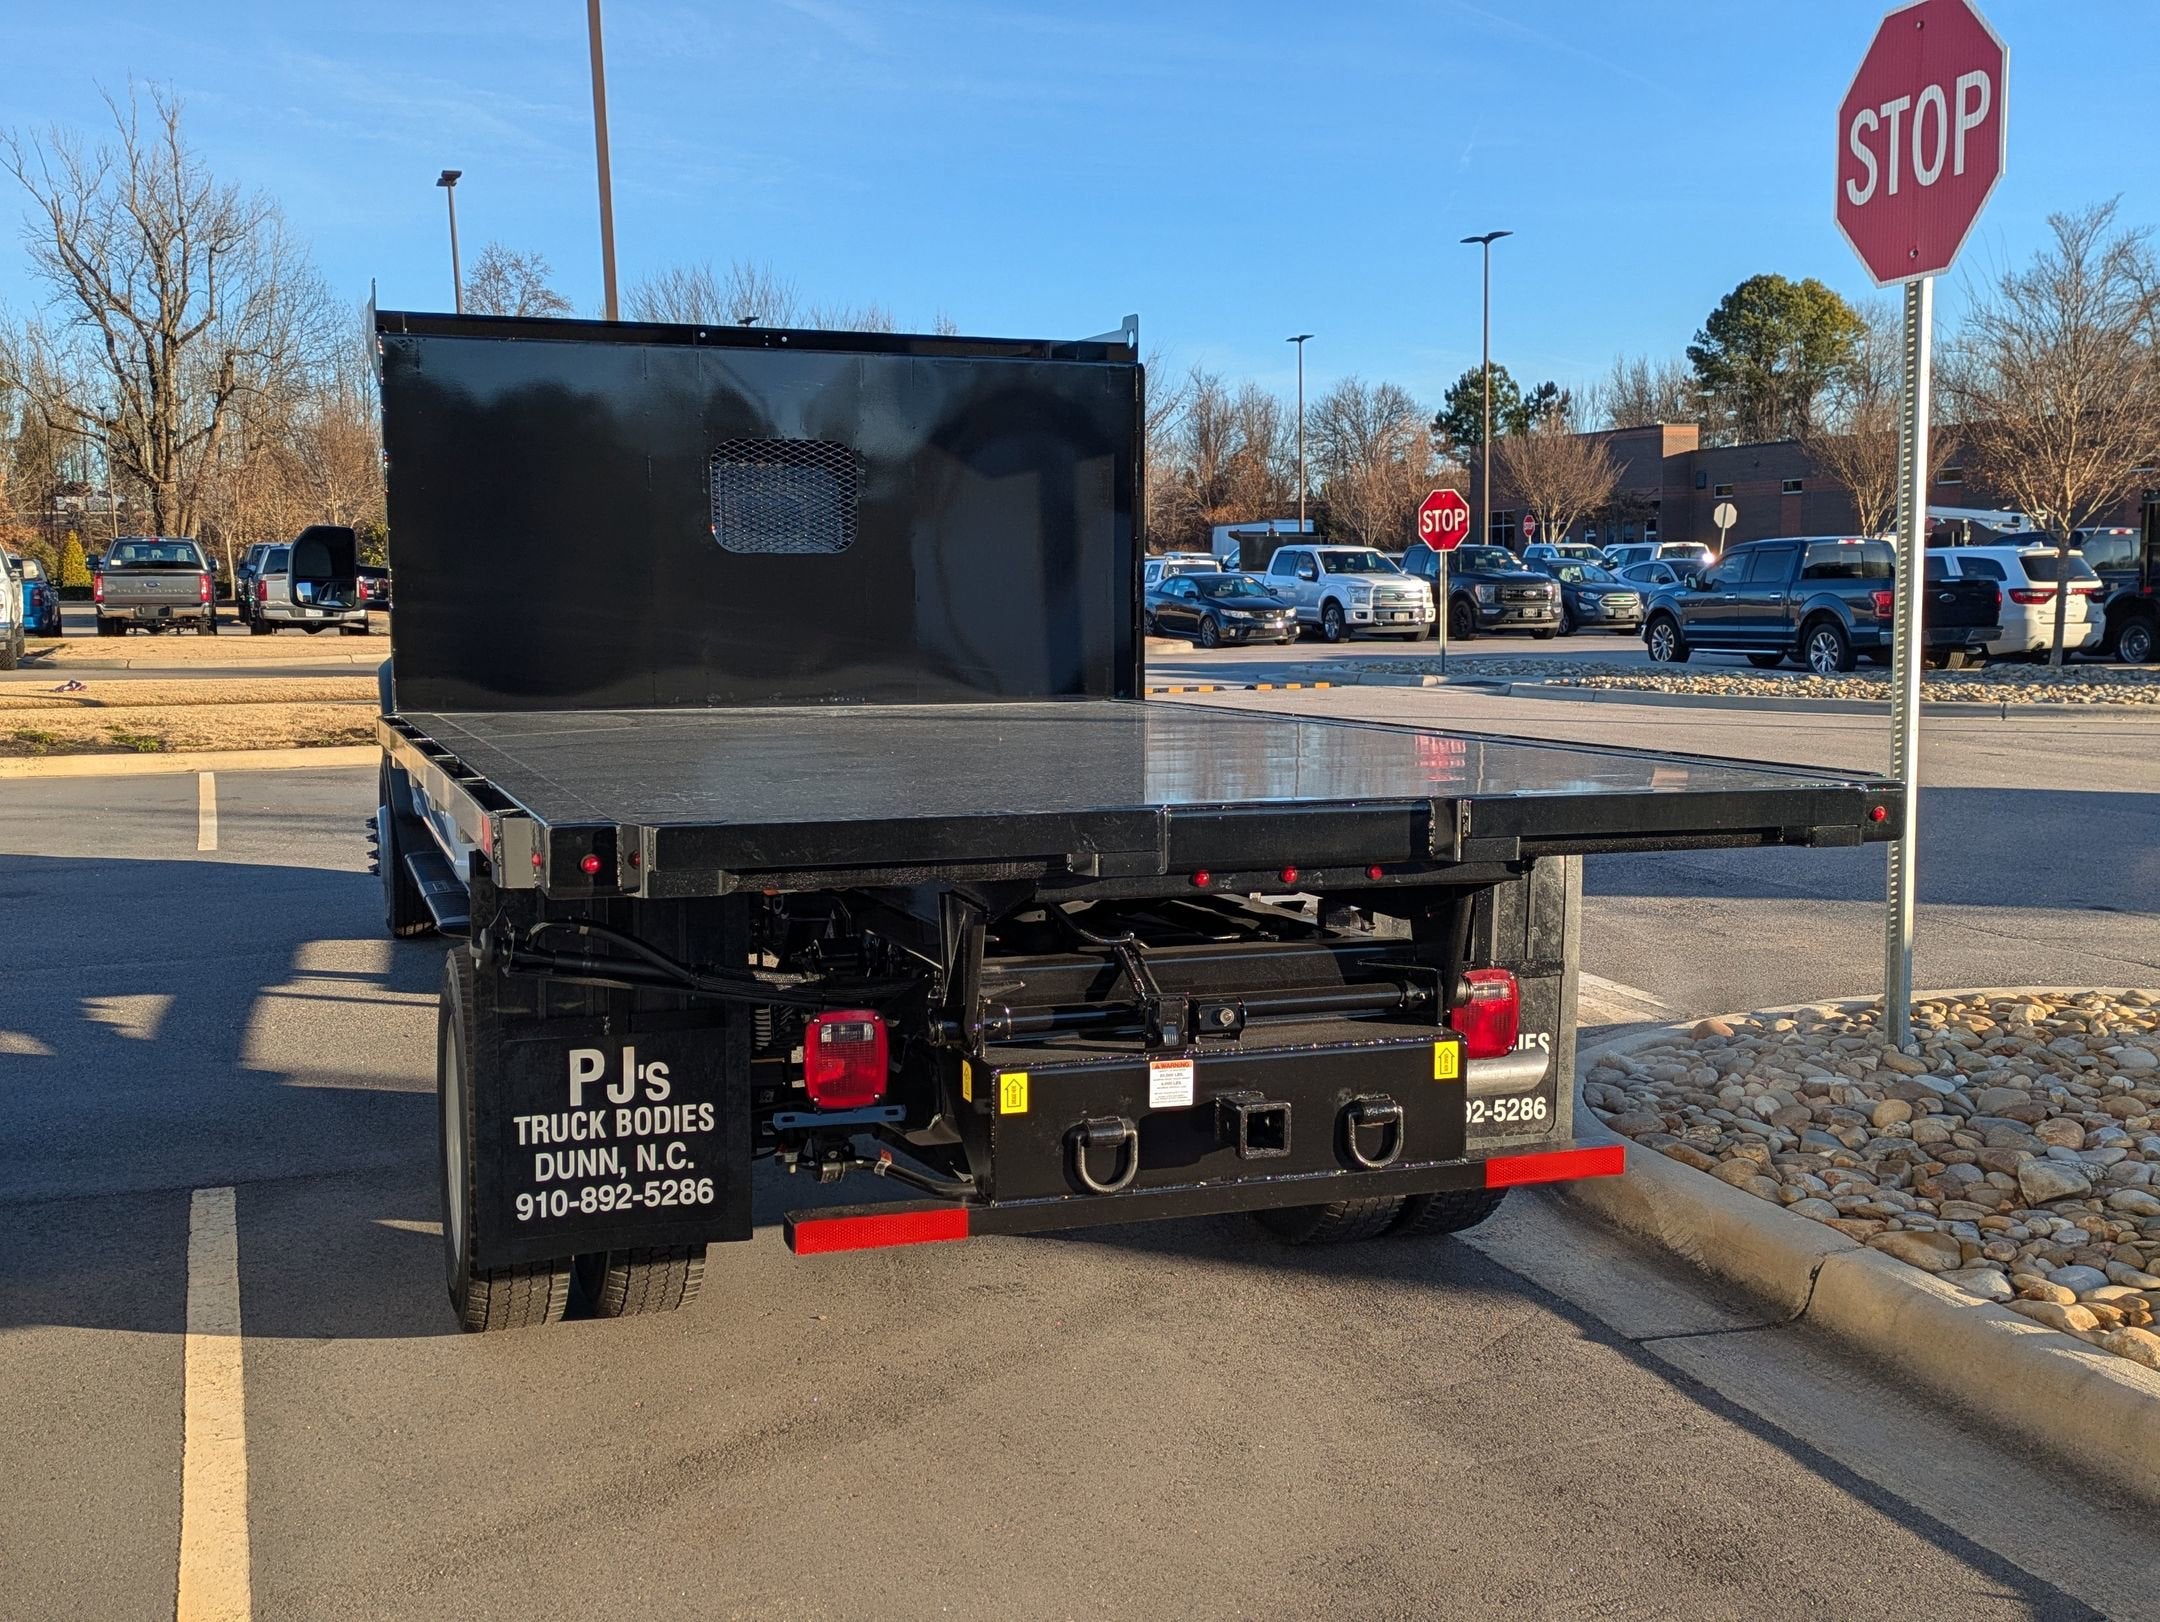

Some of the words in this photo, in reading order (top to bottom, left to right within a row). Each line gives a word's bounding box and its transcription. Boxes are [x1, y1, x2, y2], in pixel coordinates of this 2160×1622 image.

[1846, 69, 1991, 206] STOP
[1422, 508, 1466, 533] STOP
[513, 1110, 607, 1145] TRUCK
[616, 1103, 715, 1137] BODIES
[535, 1146, 627, 1182] DUNN,
[637, 1141, 695, 1172] N.C.
[515, 1178, 715, 1221] 910-892-5286
